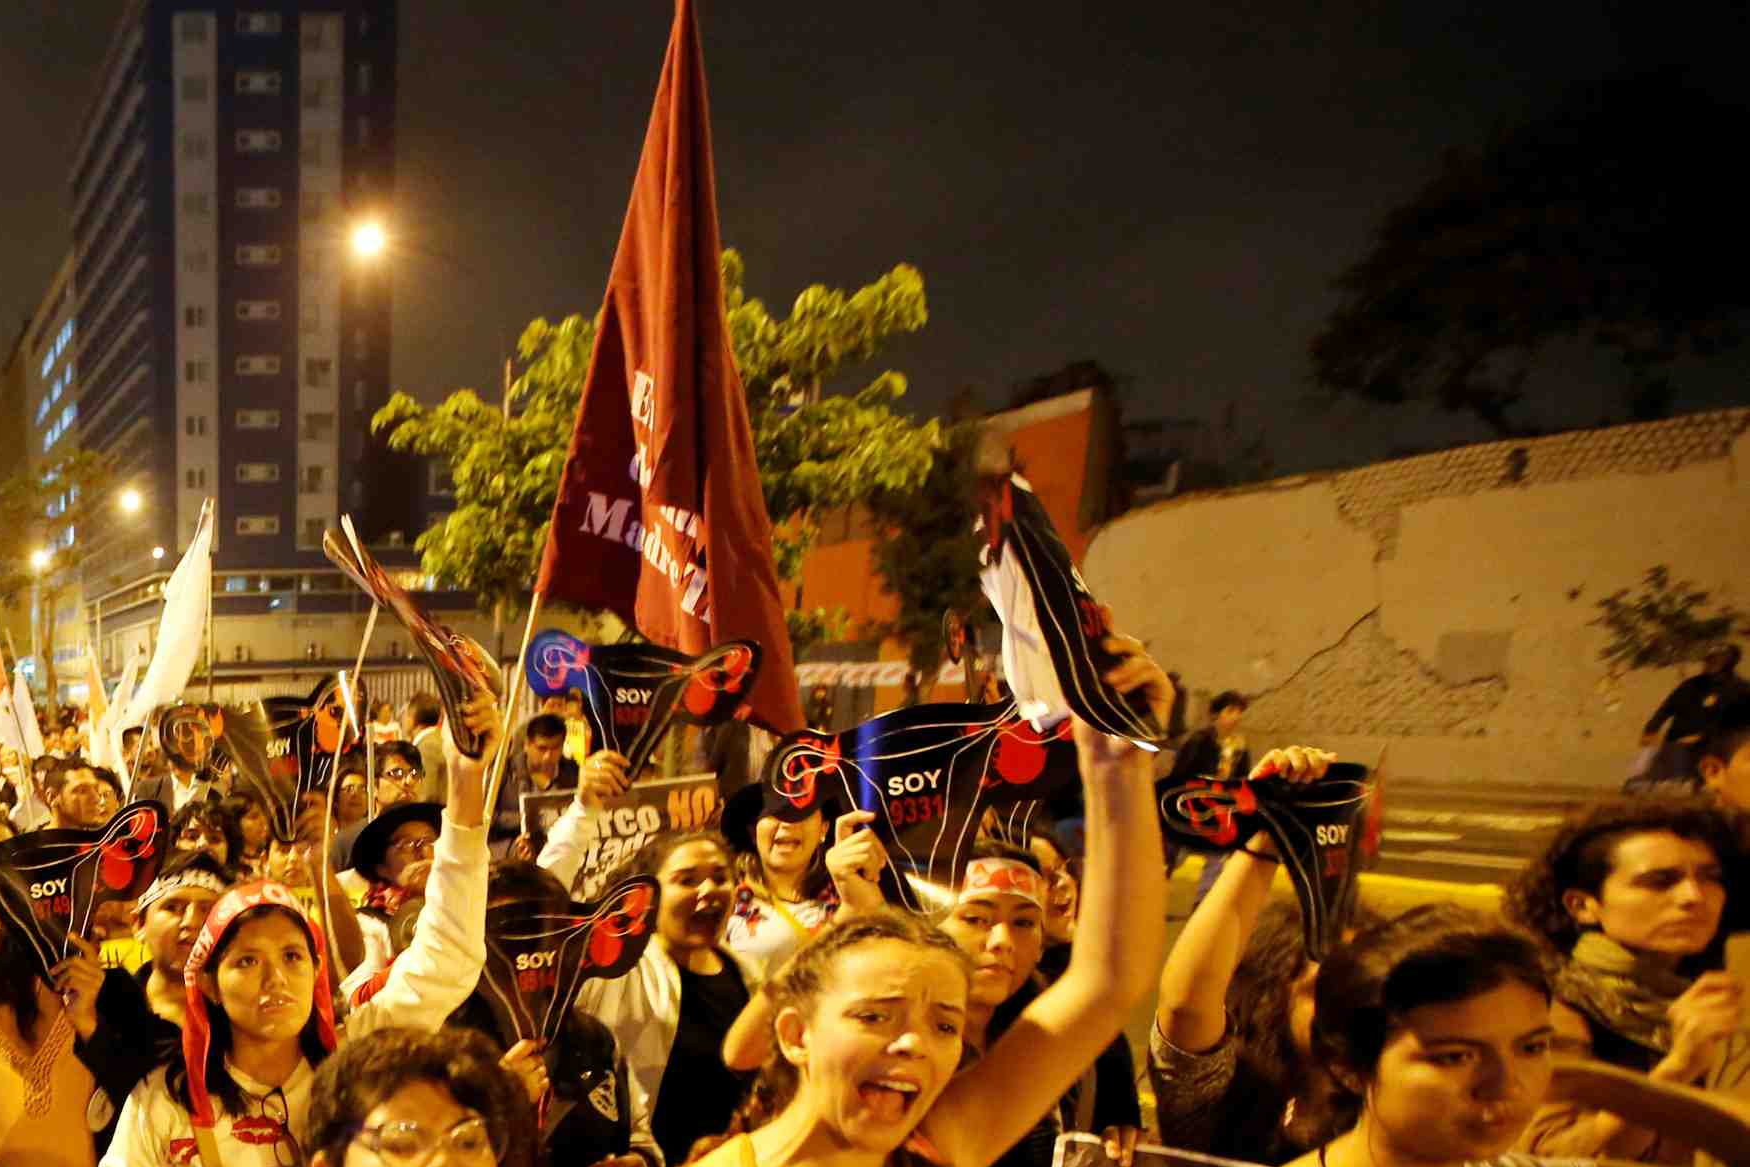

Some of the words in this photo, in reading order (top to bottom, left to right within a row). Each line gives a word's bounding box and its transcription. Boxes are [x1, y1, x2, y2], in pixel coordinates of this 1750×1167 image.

[616, 687, 652, 704] SOY
[888, 767, 943, 796] SOY
[667, 785, 716, 831] NO
[1315, 823, 1350, 846] SOY
[30, 877, 68, 899] SOY
[516, 949, 557, 971] SOY
